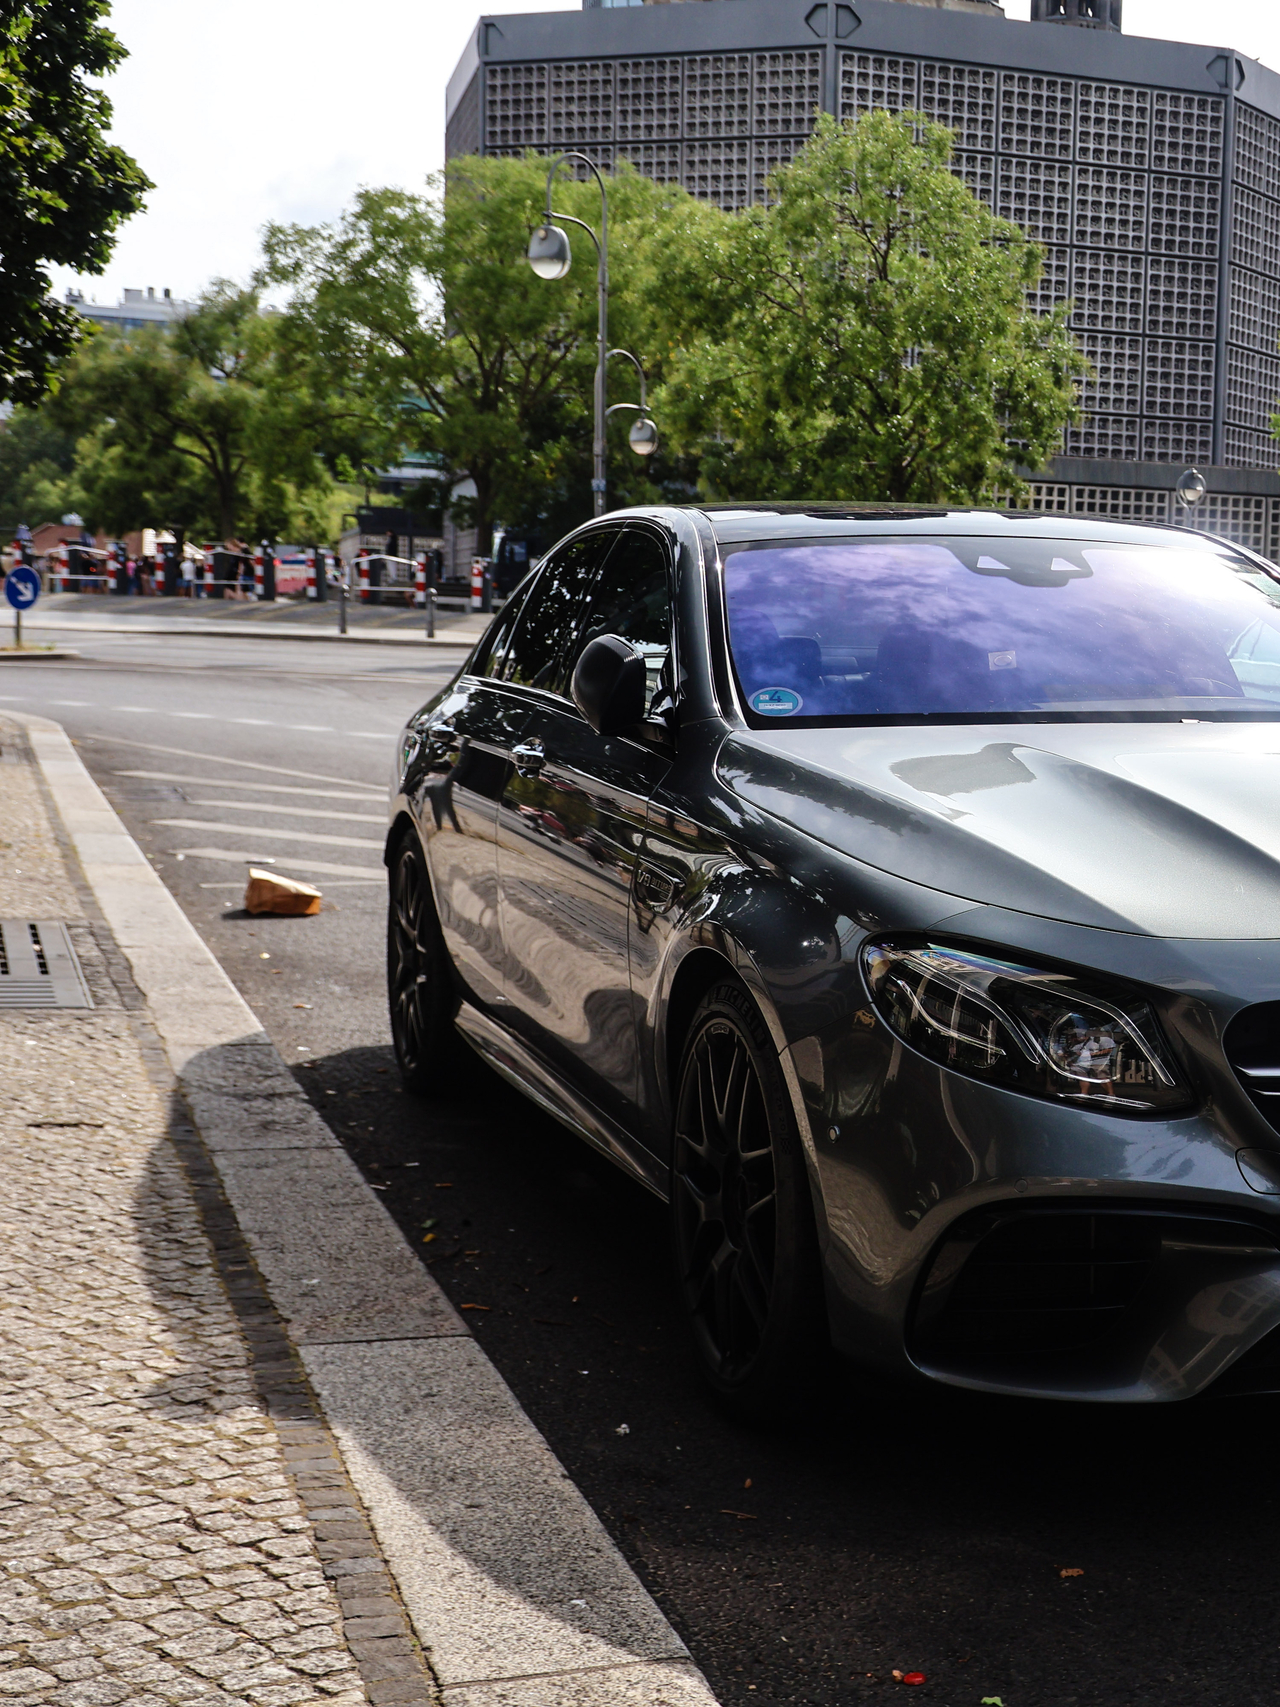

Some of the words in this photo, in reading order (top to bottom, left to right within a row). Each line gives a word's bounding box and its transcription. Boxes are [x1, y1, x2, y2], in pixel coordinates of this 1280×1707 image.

[769, 691, 782, 702] 4
[717, 985, 766, 1047] MICHELIN
[778, 1117, 787, 1132] 20
